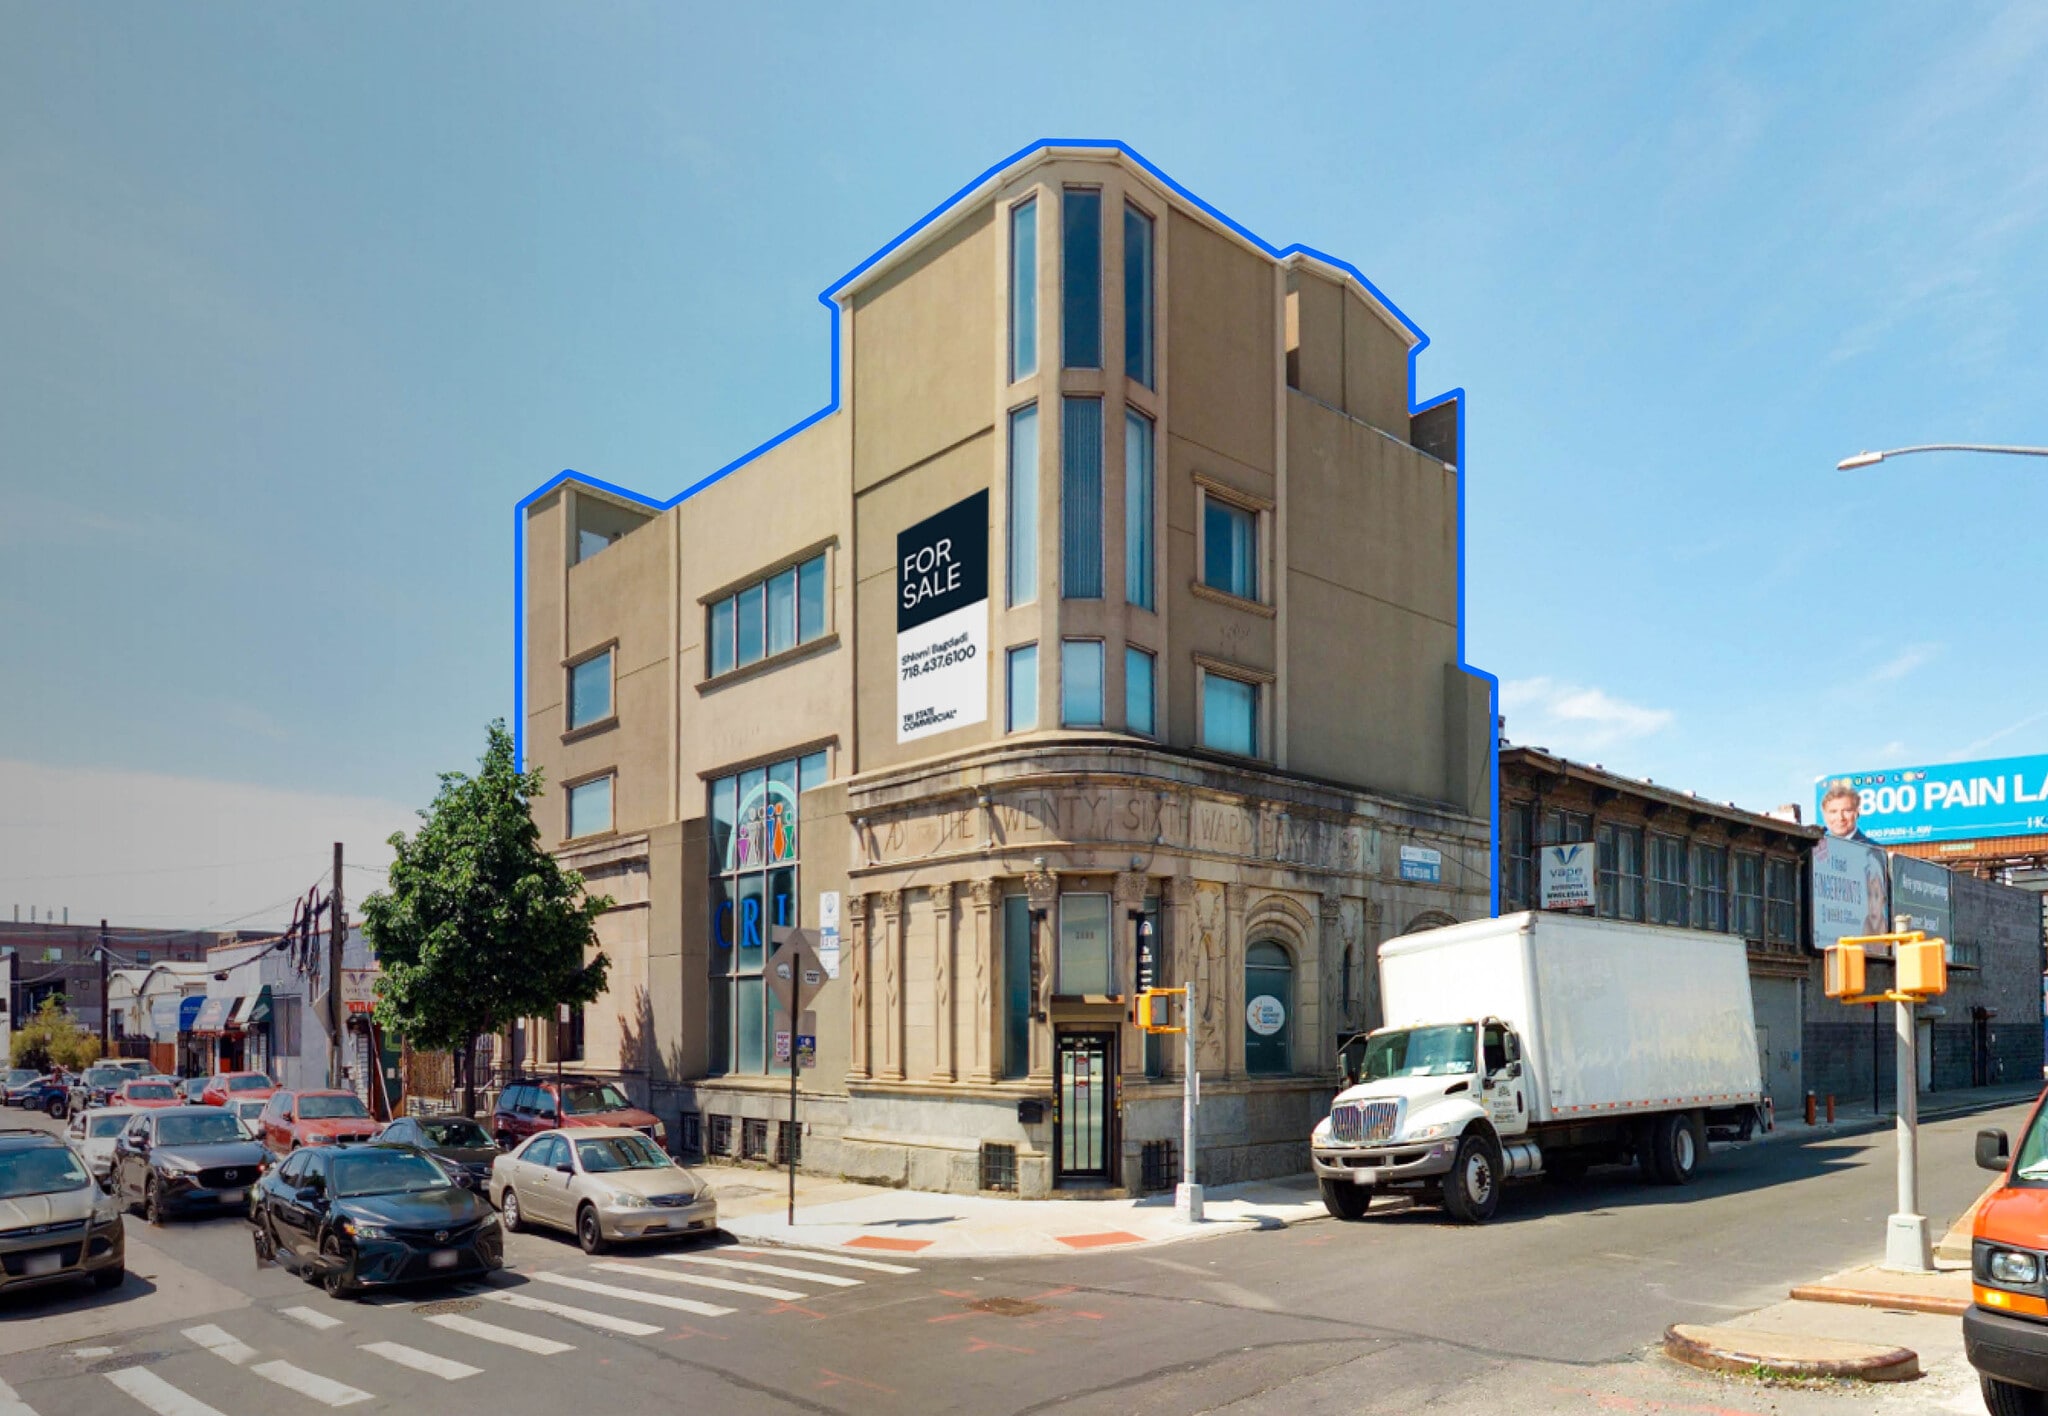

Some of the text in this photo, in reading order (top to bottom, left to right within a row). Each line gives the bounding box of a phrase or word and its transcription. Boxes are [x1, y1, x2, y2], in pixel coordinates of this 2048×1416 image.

[903, 538, 952, 582] FOR
[903, 562, 962, 609] SALE
[902, 647, 930, 666] Shlomi
[902, 645, 976, 681] 718.437.6100
[903, 706, 935, 723] TRI STATE
[1859, 785, 1917, 816] 800
[1923, 774, 2006, 811] PAIN
[937, 809, 974, 841] THE
[988, 795, 1107, 834] WENTY
[1122, 799, 1191, 838] SIXTH
